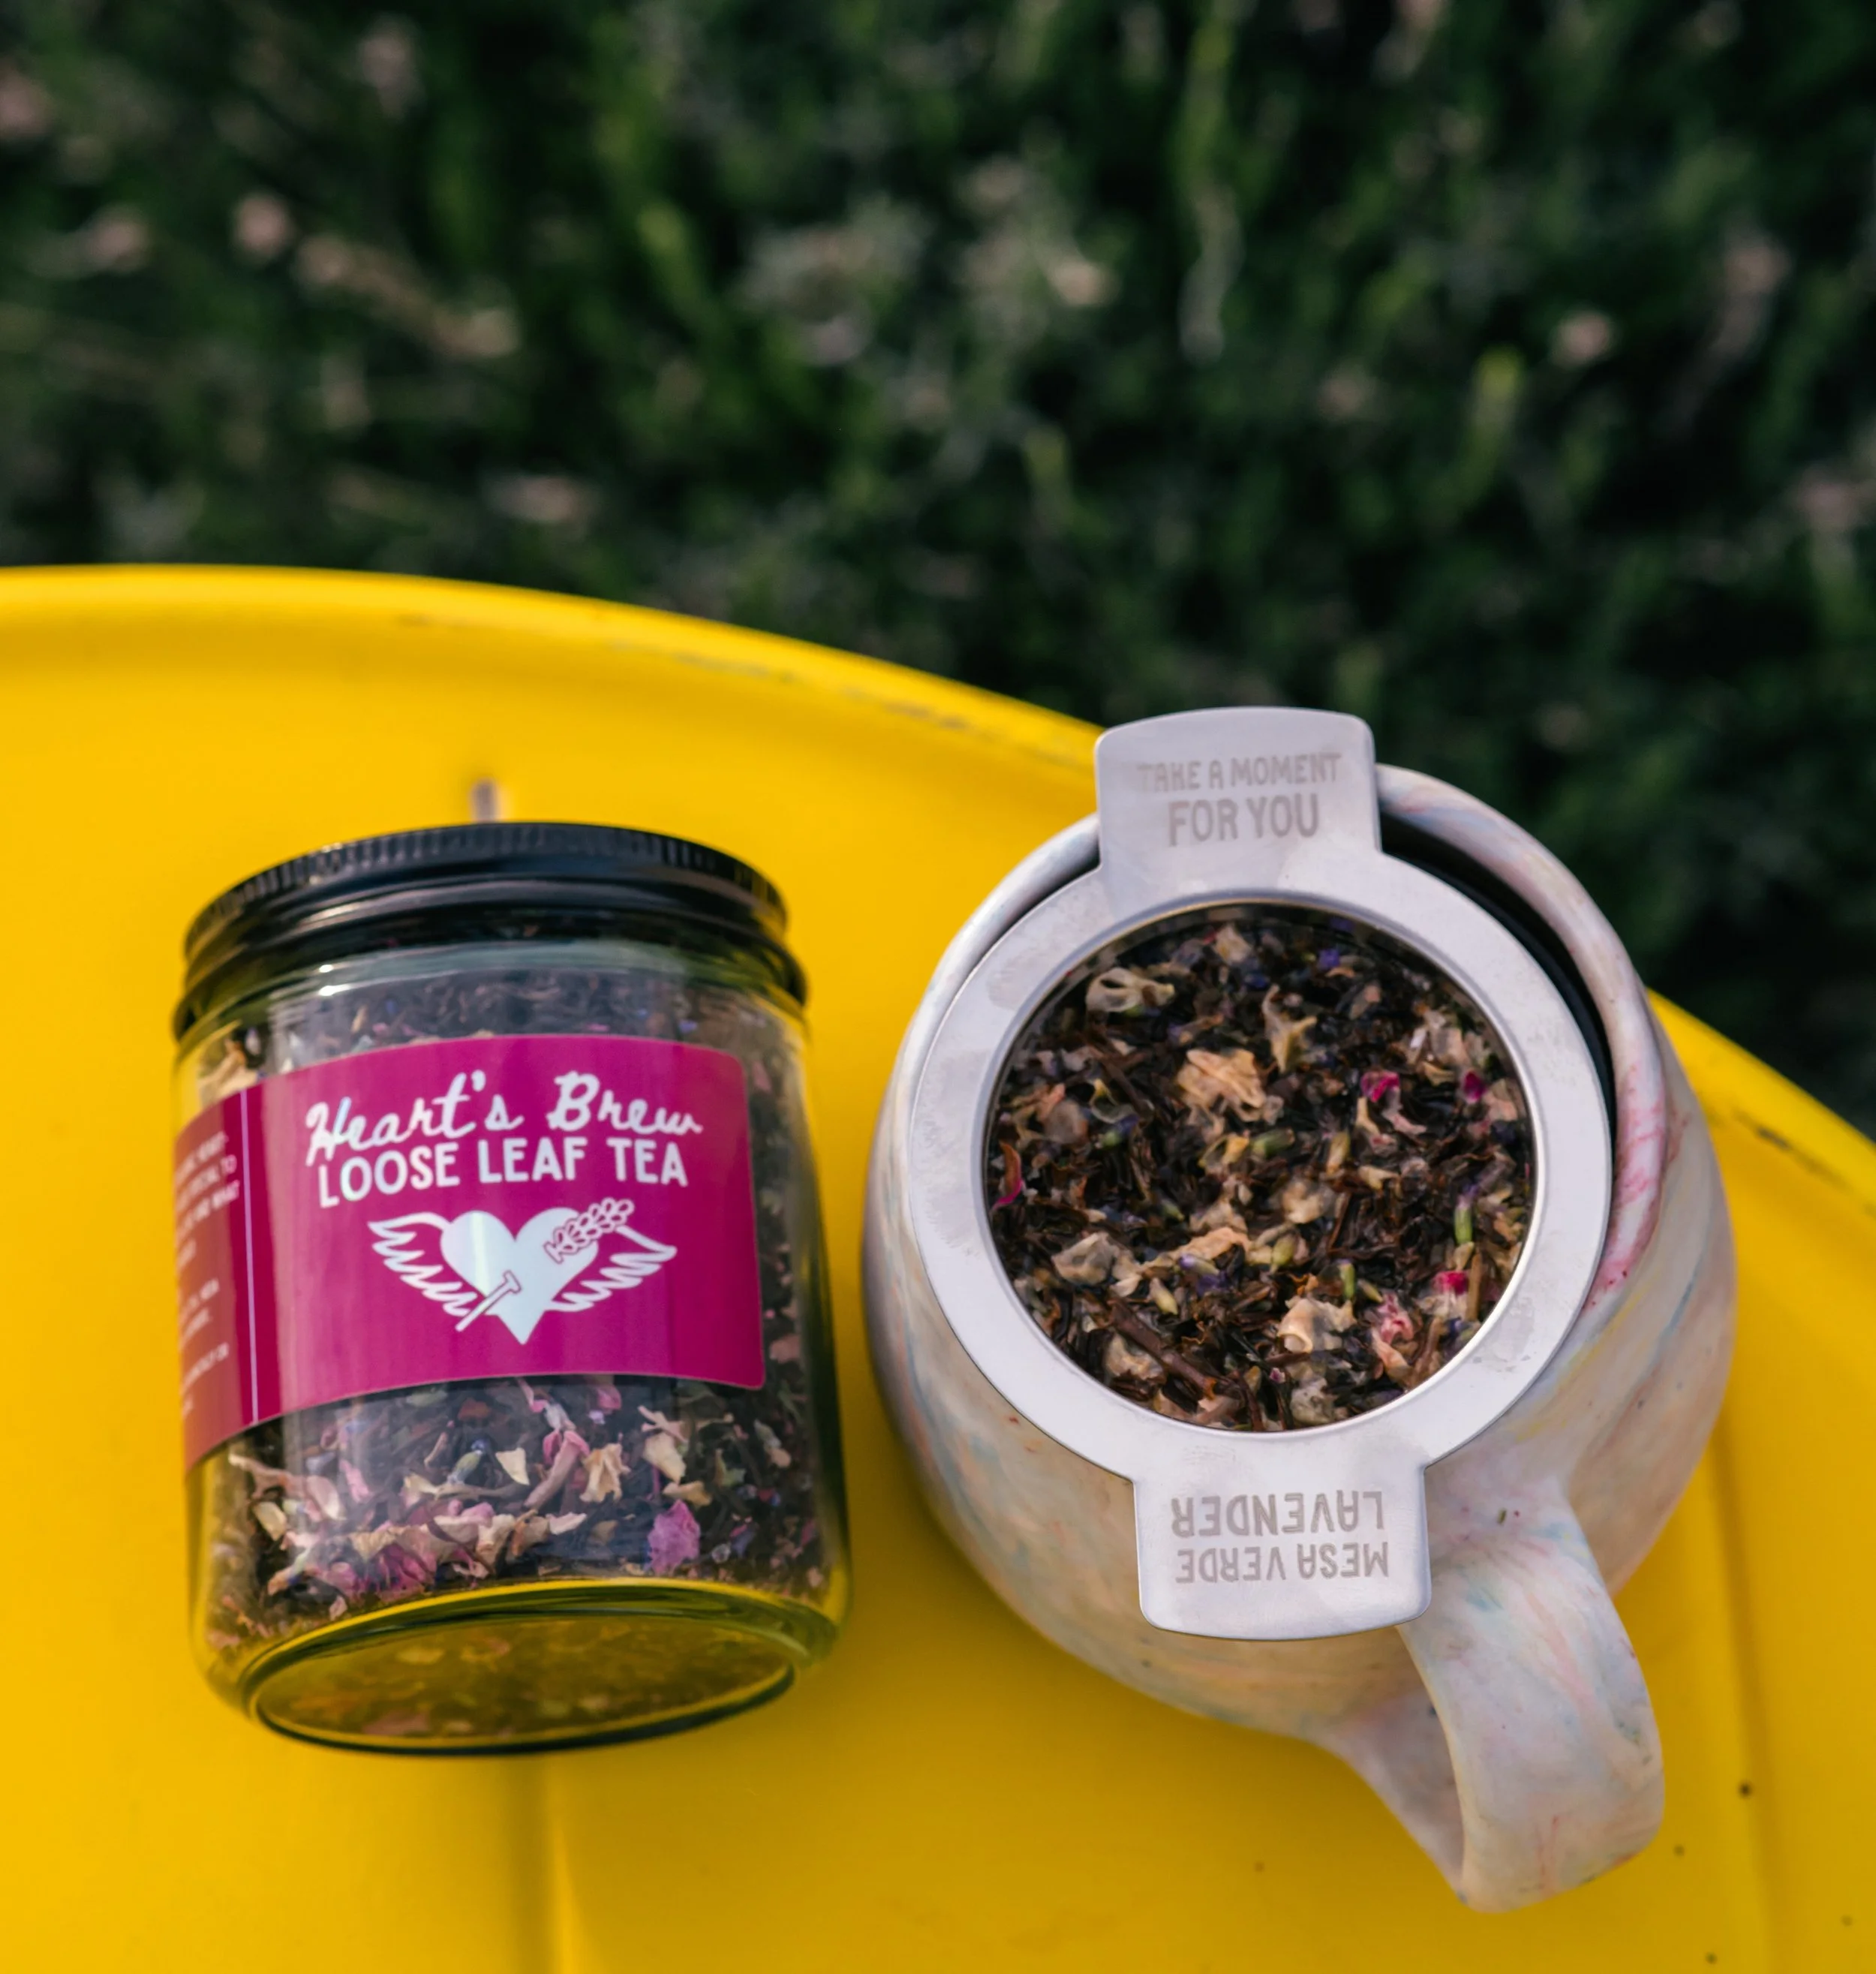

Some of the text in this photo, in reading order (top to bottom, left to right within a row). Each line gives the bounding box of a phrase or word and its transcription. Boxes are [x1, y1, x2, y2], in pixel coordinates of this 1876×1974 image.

[1136, 751, 1342, 793] TAKE A MOMENT
[1168, 792, 1320, 847] FOR YOU
[305, 1069, 525, 1166] Heart's
[545, 1070, 703, 1135] Brew
[317, 1136, 689, 1209] LOOSE LEAF TEA
[1170, 1489, 1384, 1538] LAVENDER
[1175, 1541, 1389, 1584] MESA VERDE
